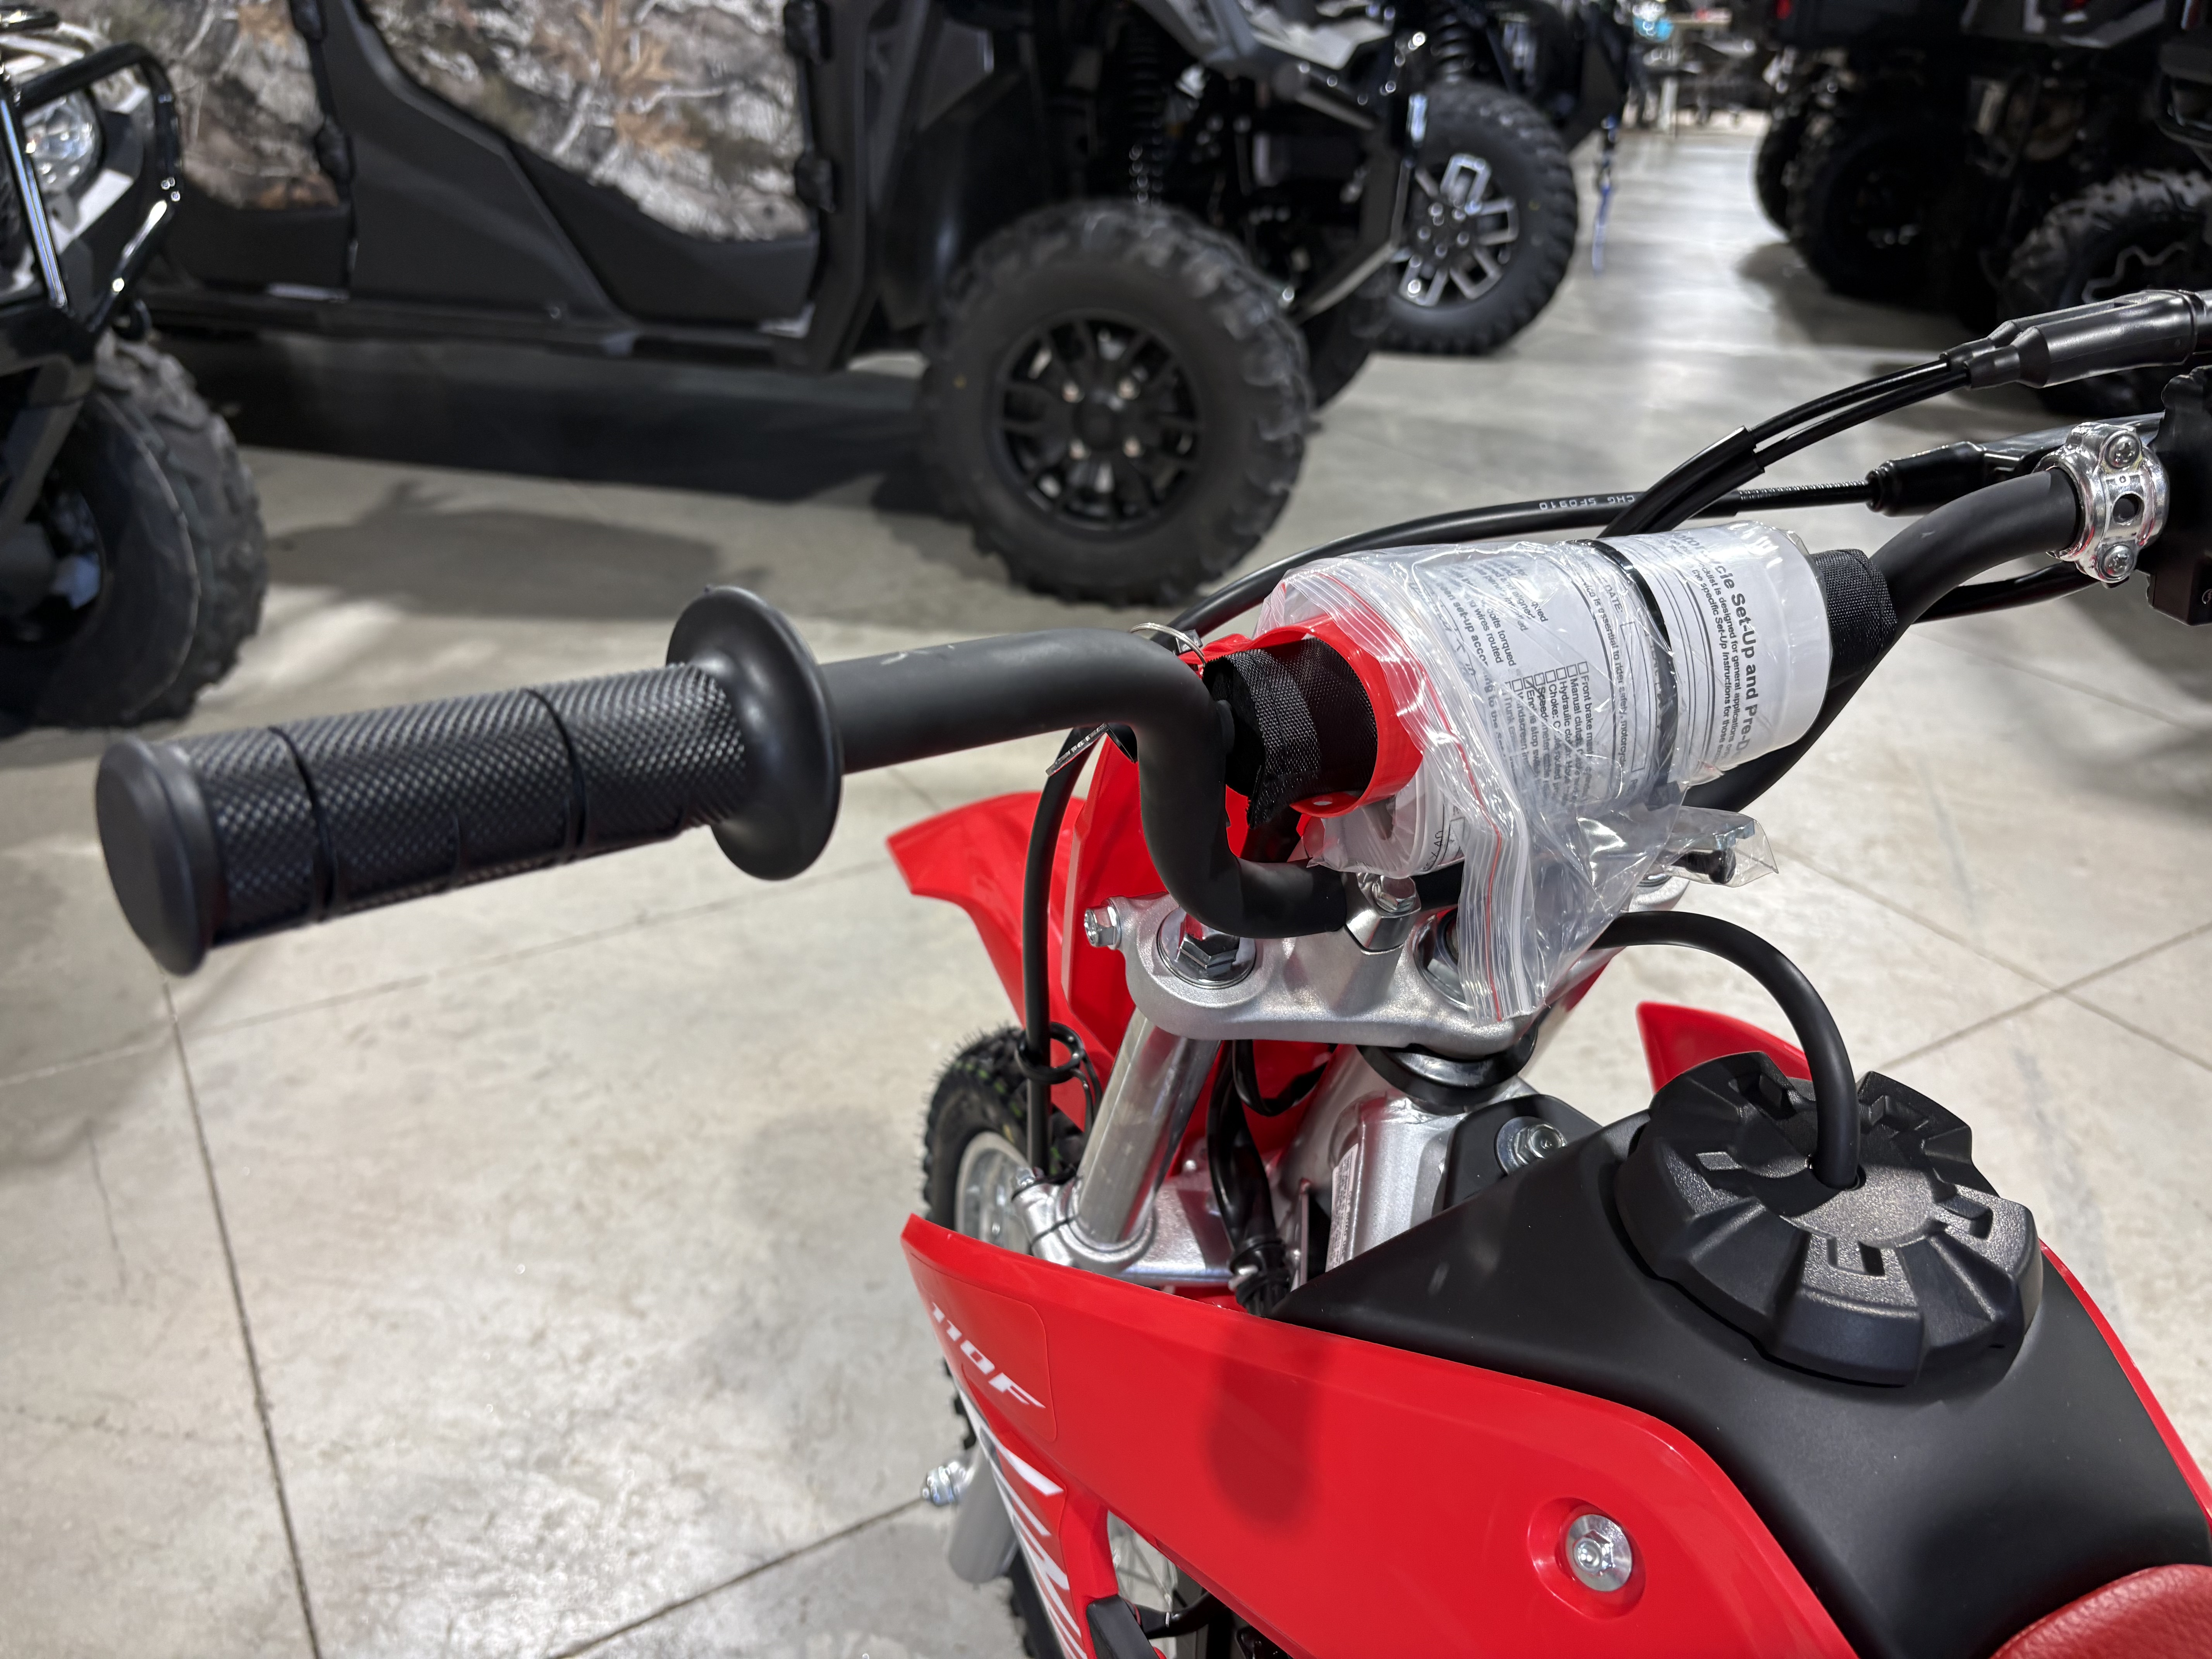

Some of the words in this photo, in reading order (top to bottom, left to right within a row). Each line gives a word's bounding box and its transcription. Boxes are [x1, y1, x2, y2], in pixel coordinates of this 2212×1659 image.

[1607, 495, 1636, 505] CHG
[1692, 569, 1703, 582] the
[1714, 587, 1722, 596] is
[1700, 582, 1717, 616] specific
[1452, 602, 1475, 633] set-up
[1593, 596, 1601, 606] is
[1598, 608, 1616, 648] essential
[1612, 648, 1620, 660] to
[1715, 617, 1728, 650] Set-Up
[1719, 598, 1737, 639] designed
[1731, 593, 1756, 659] Set-Up
[1474, 608, 1490, 632] wires
[1486, 633, 1504, 664] routed
[1497, 630, 1516, 667] torqued
[1731, 640, 1739, 654] for
[1580, 675, 1590, 701] Front
[1722, 651, 1733, 705] Instructions
[1731, 655, 1741, 690] general
[1746, 664, 1759, 700] and
[1548, 684, 1559, 718] Choke:
[1559, 681, 1570, 726] Hydraulic
[1570, 678, 1582, 714] Manual
[1723, 706, 1732, 716] for
[1584, 702, 1593, 730] brake
[1719, 717, 1730, 743] those
[1729, 692, 1741, 740] applications
[1736, 704, 1758, 753] Pre-D
[1530, 725, 1539, 747] stop
[931, 1302, 1046, 1409] 110F
